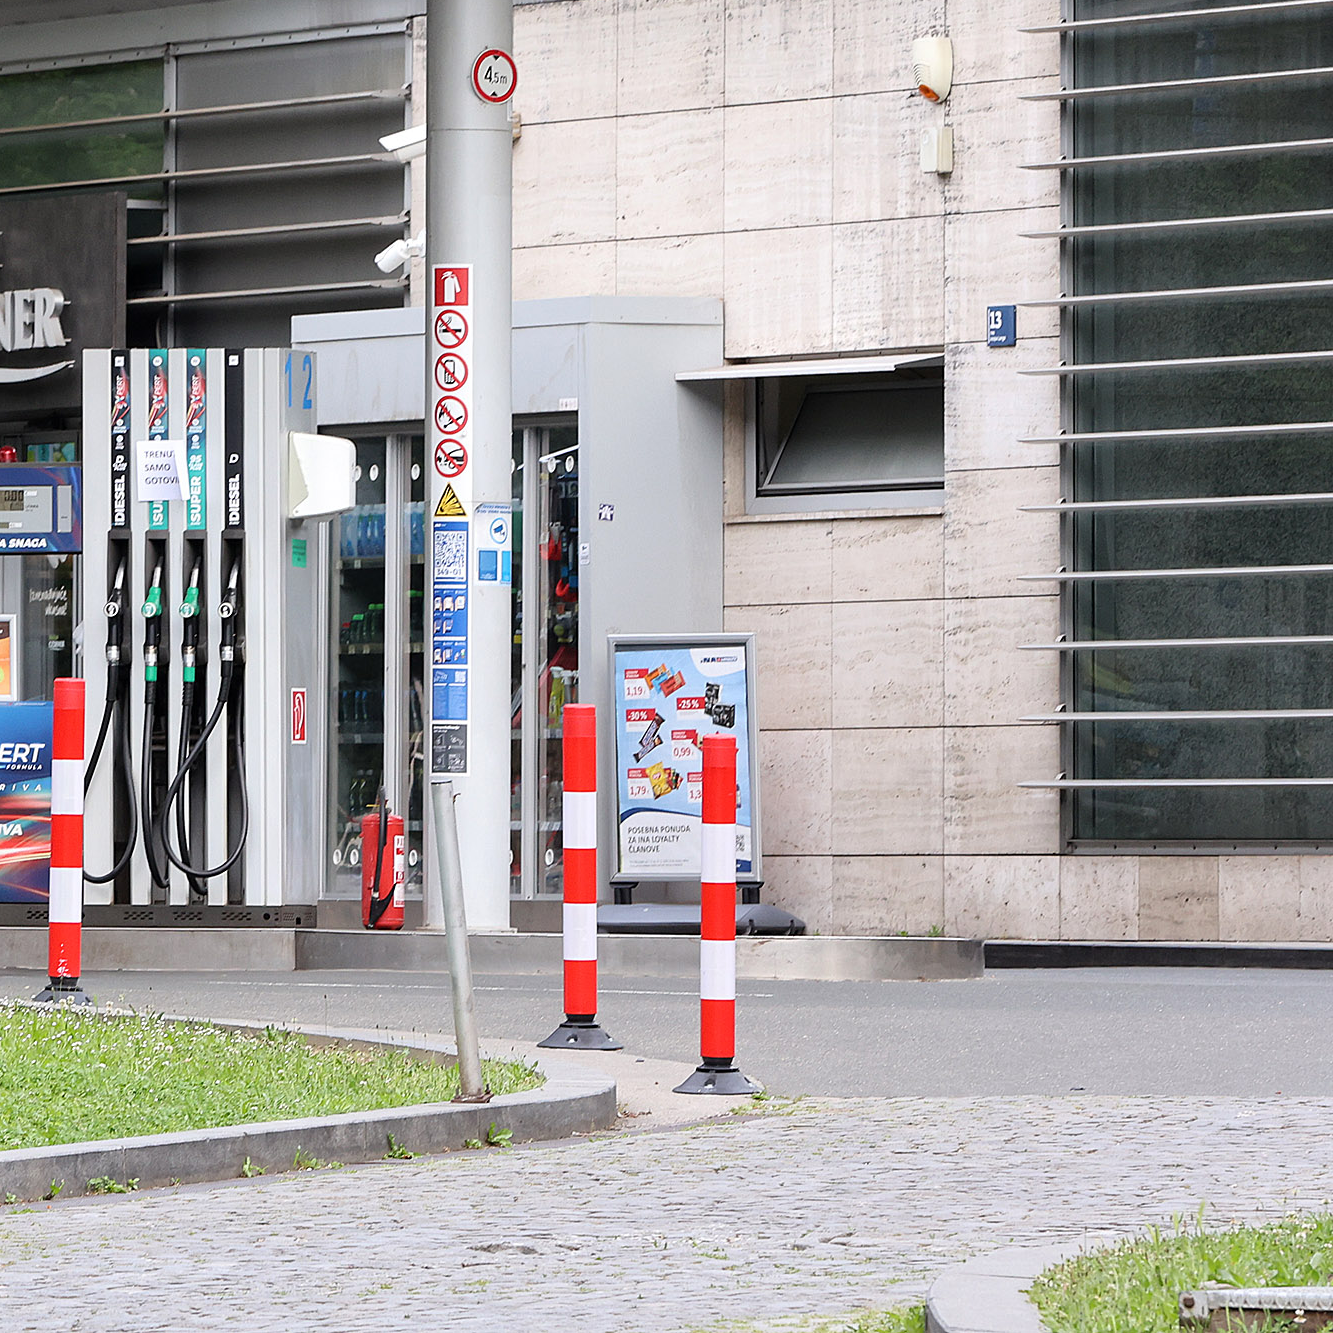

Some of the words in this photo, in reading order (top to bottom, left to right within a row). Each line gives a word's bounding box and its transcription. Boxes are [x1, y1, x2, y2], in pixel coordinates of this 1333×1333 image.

[302, 354, 312, 409] 2
[144, 450, 175, 458] TRENU
[228, 453, 239, 464] D
[145, 464, 170, 472] SAMO
[145, 477, 180, 485] GOTOVI
[8, 538, 48, 549] SNAGA
[679, 699, 700, 709] -25%
[628, 711, 648, 720] -30%
[689, 790, 702, 799] 1,3
[660, 825, 691, 834] PONUDA
